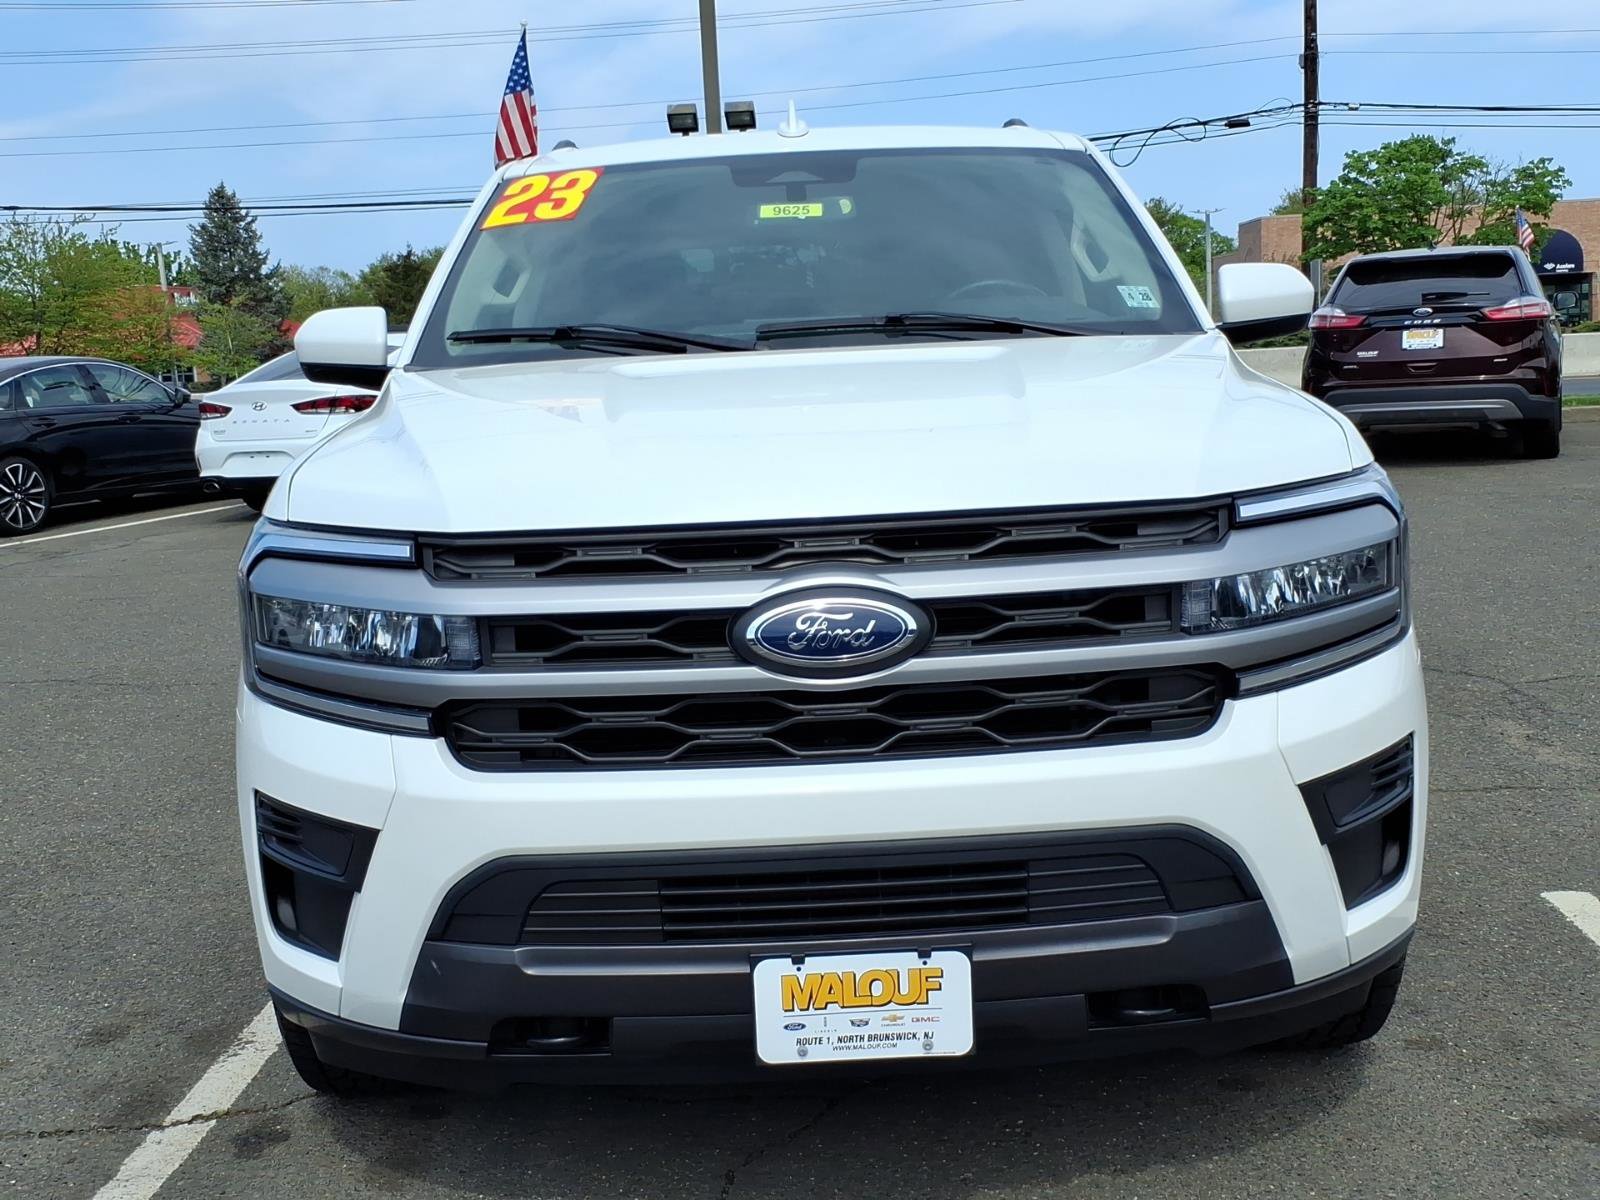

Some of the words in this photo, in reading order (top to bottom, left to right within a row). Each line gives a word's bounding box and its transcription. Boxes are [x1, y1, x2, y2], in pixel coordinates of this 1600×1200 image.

[481, 169, 598, 229] 23
[773, 205, 811, 217] 9625
[787, 611, 877, 651] Ford
[781, 967, 944, 1012] MALOUF
[796, 1036, 824, 1047] ROUTE
[826, 1036, 834, 1046] 1,
[836, 1034, 865, 1045] NORTH
[867, 1031, 921, 1043] BRUNSWICK,
[923, 1031, 935, 1041] NJ
[832, 1042, 898, 1052] WWW.MALOUF.COM
